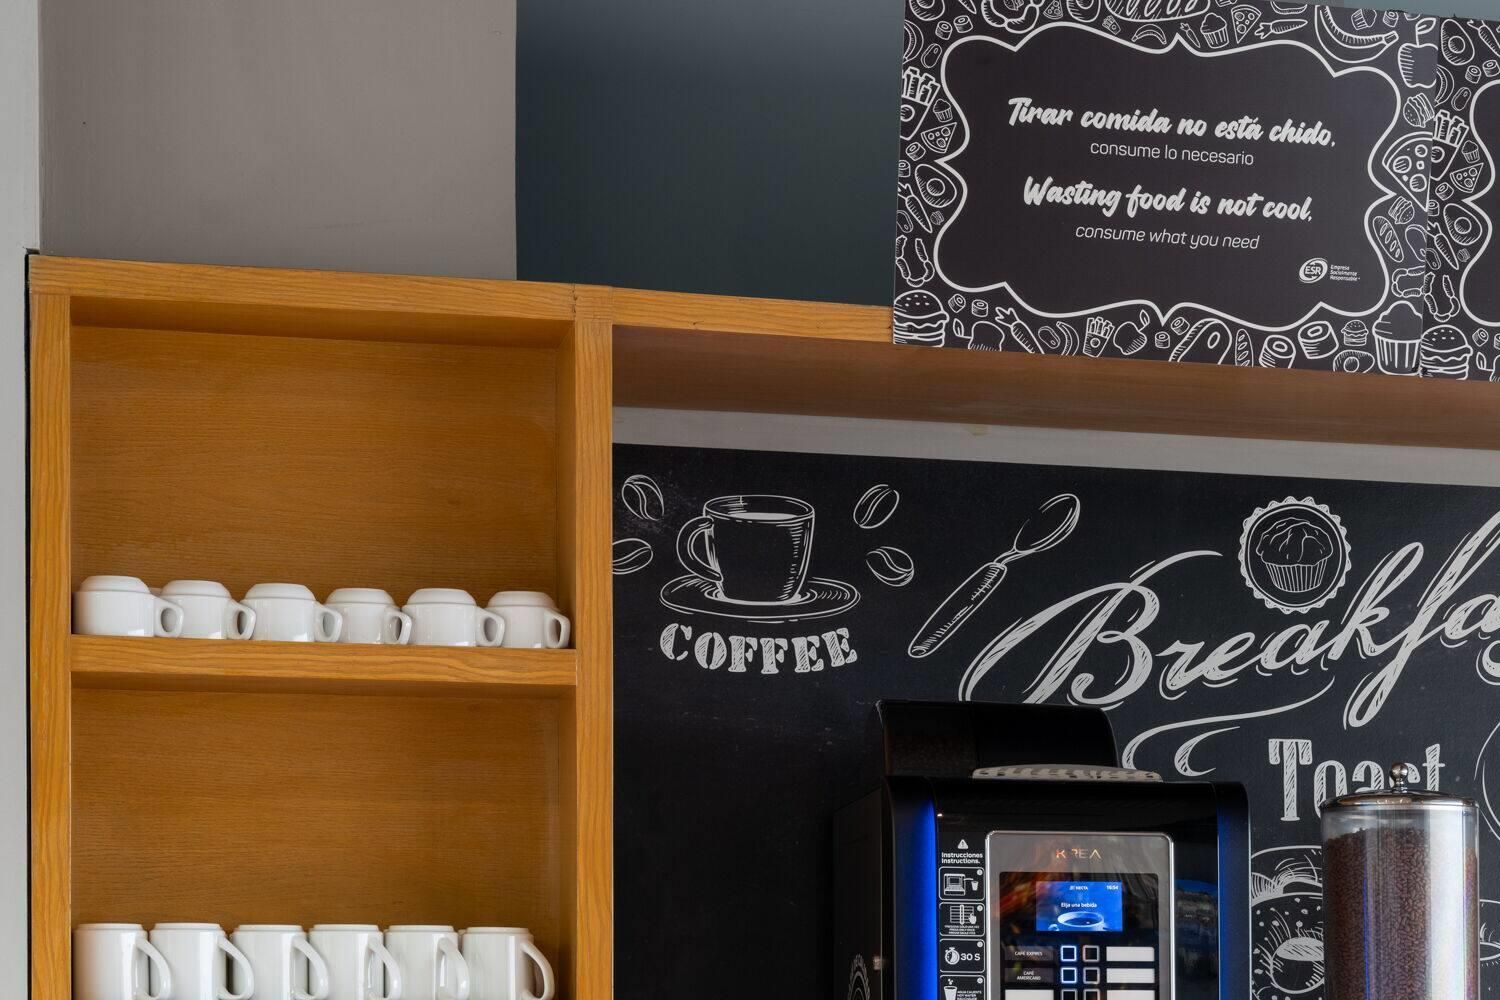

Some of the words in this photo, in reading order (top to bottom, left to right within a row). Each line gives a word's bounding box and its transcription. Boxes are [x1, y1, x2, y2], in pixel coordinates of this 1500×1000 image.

[1008, 97, 1073, 126] Tirar
[1080, 108, 1172, 136] comida
[1176, 116, 1207, 137] no
[1214, 116, 1264, 141] está
[1090, 142, 1161, 159] consume
[1164, 145, 1178, 160] lo
[1182, 149, 1254, 166] necesario
[1023, 176, 1122, 217] Wasting
[1126, 184, 1187, 218] food
[1189, 188, 1211, 214] is
[1217, 192, 1264, 216] not
[1075, 225, 1145, 241] consume
[1149, 228, 1188, 245] what
[1189, 233, 1220, 250] you
[1222, 234, 1260, 250] need
[1305, 266, 1321, 275] ESR
[659, 622, 858, 675] COFFEE
